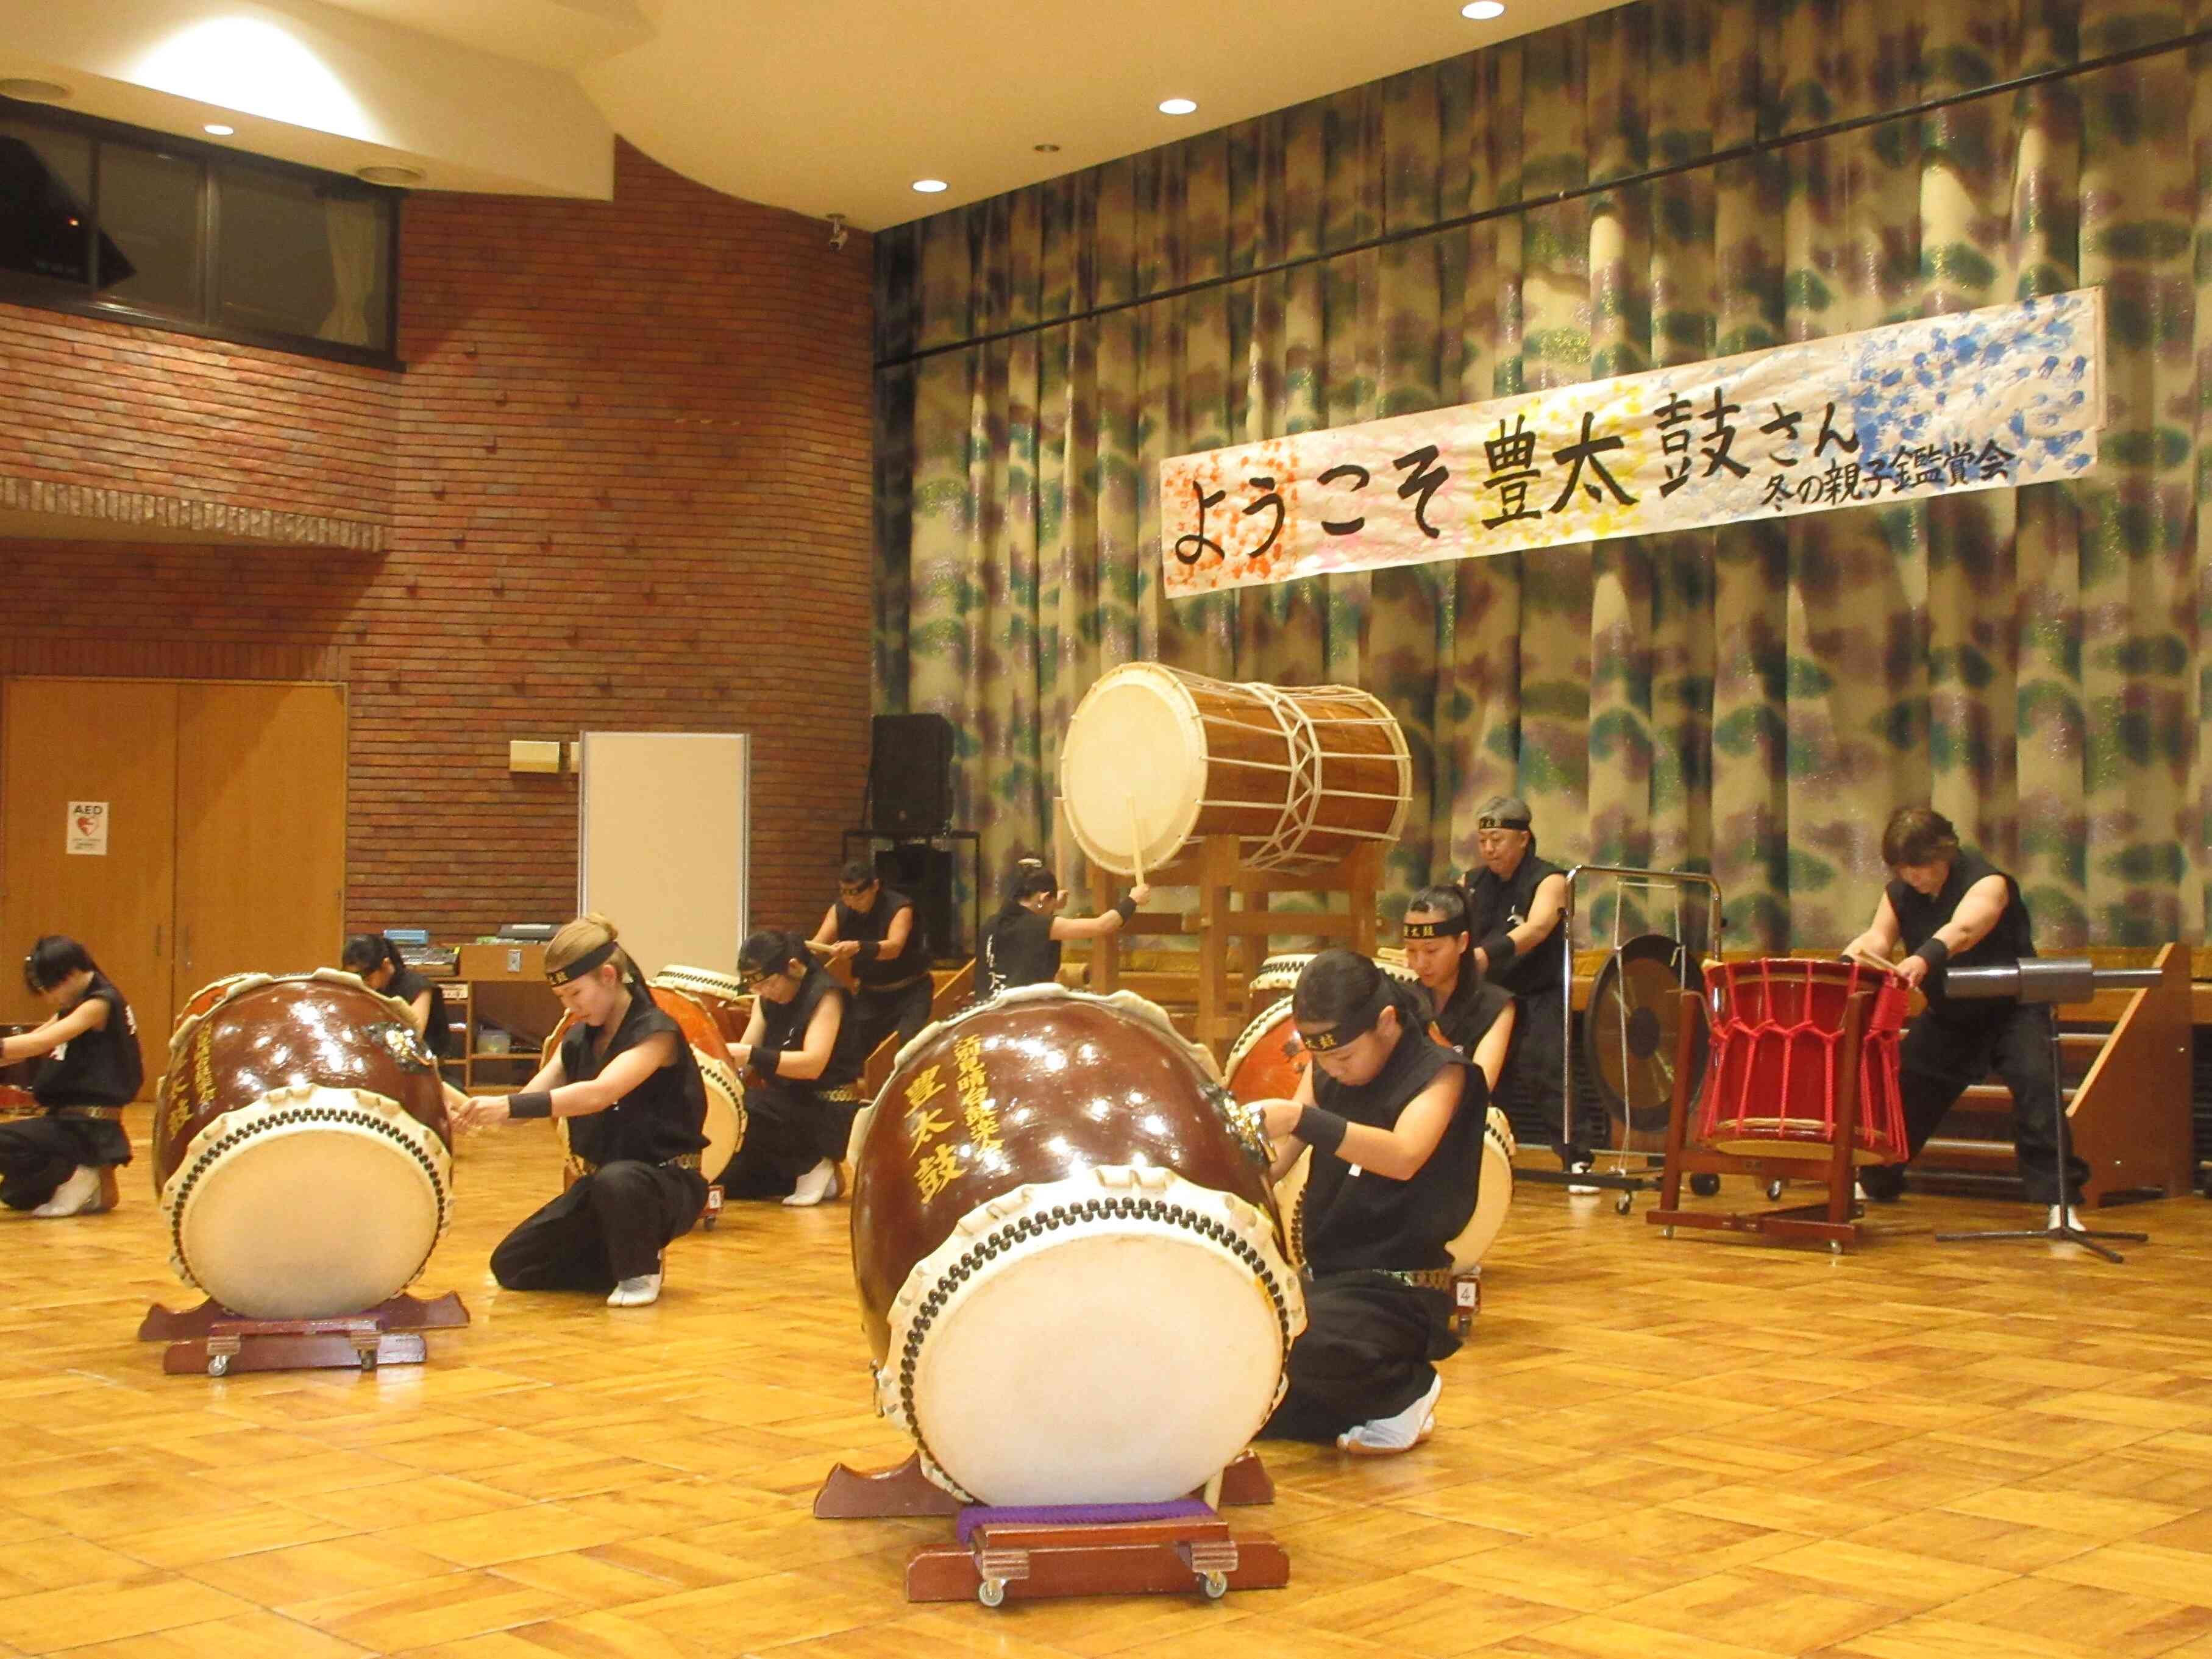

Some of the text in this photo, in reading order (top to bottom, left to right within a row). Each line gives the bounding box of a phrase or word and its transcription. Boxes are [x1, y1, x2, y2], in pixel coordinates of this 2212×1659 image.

[1761, 439, 2016, 512] 冬の親子鑑賞会
[74, 805, 103, 815] AED
[904, 1064, 968, 1204] 豊太鼓
[1460, 1287, 1471, 1301] 4
